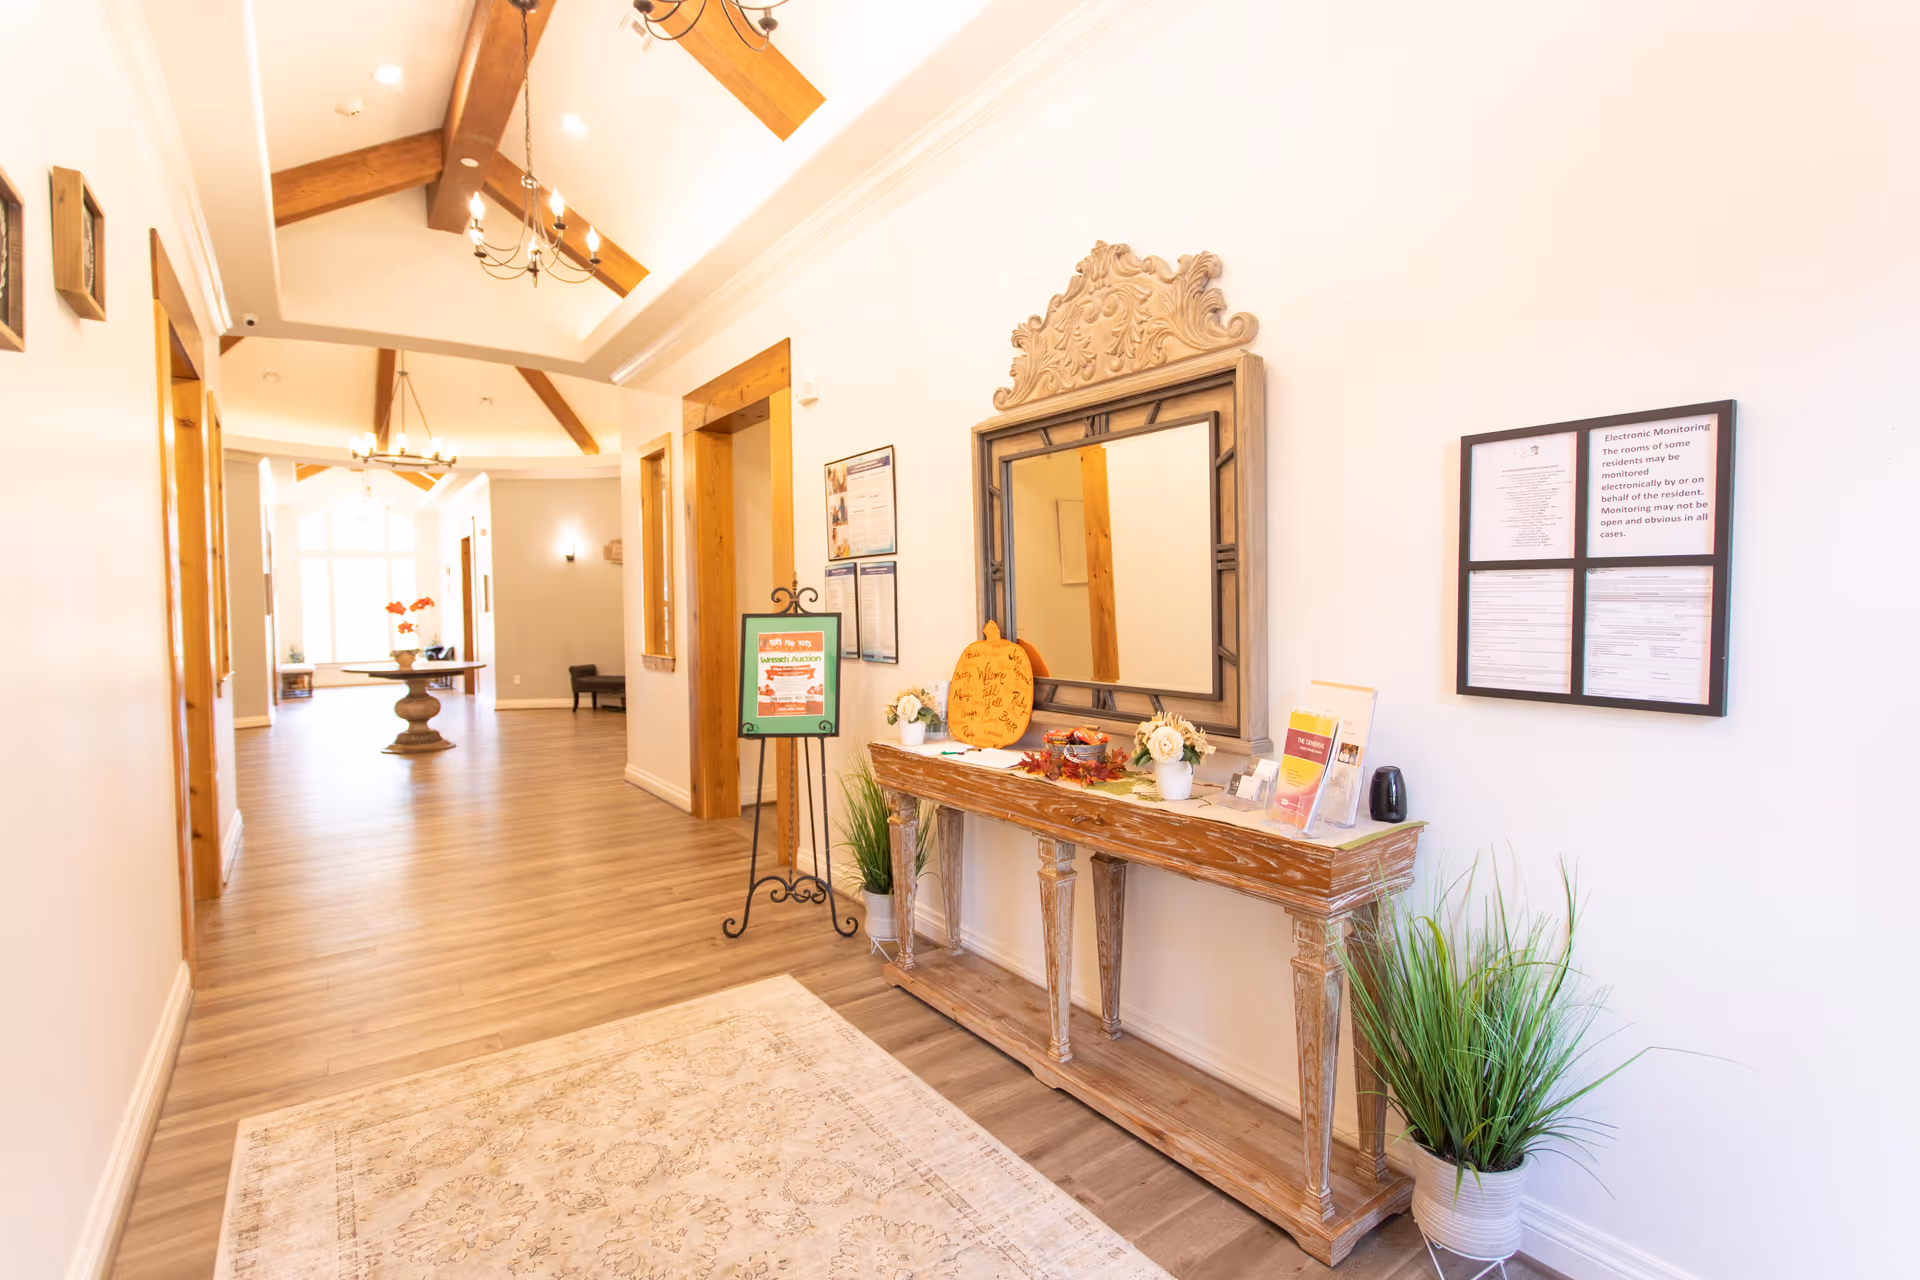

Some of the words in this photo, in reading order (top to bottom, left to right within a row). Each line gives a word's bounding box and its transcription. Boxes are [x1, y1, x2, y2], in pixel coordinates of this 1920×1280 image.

[1605, 430, 1650, 442] Electronic
[1654, 424, 1711, 436] Monitoring
[1621, 446, 1649, 454] rooms
[1652, 442, 1662, 450] of
[1665, 440, 1690, 448] some
[1602, 455, 1643, 467] residents
[1646, 454, 1665, 463] may
[1602, 468, 1649, 479] monitored
[1602, 480, 1662, 491] electronically
[1602, 494, 1629, 502] behalf
[1643, 492, 1658, 500] the
[1661, 489, 1704, 498] resident.
[1601, 504, 1651, 514] Monitoring
[1654, 504, 1674, 512] may
[1600, 519, 1623, 527] open
[1696, 513, 1708, 521] all
[977, 662, 1006, 685] Welcome
